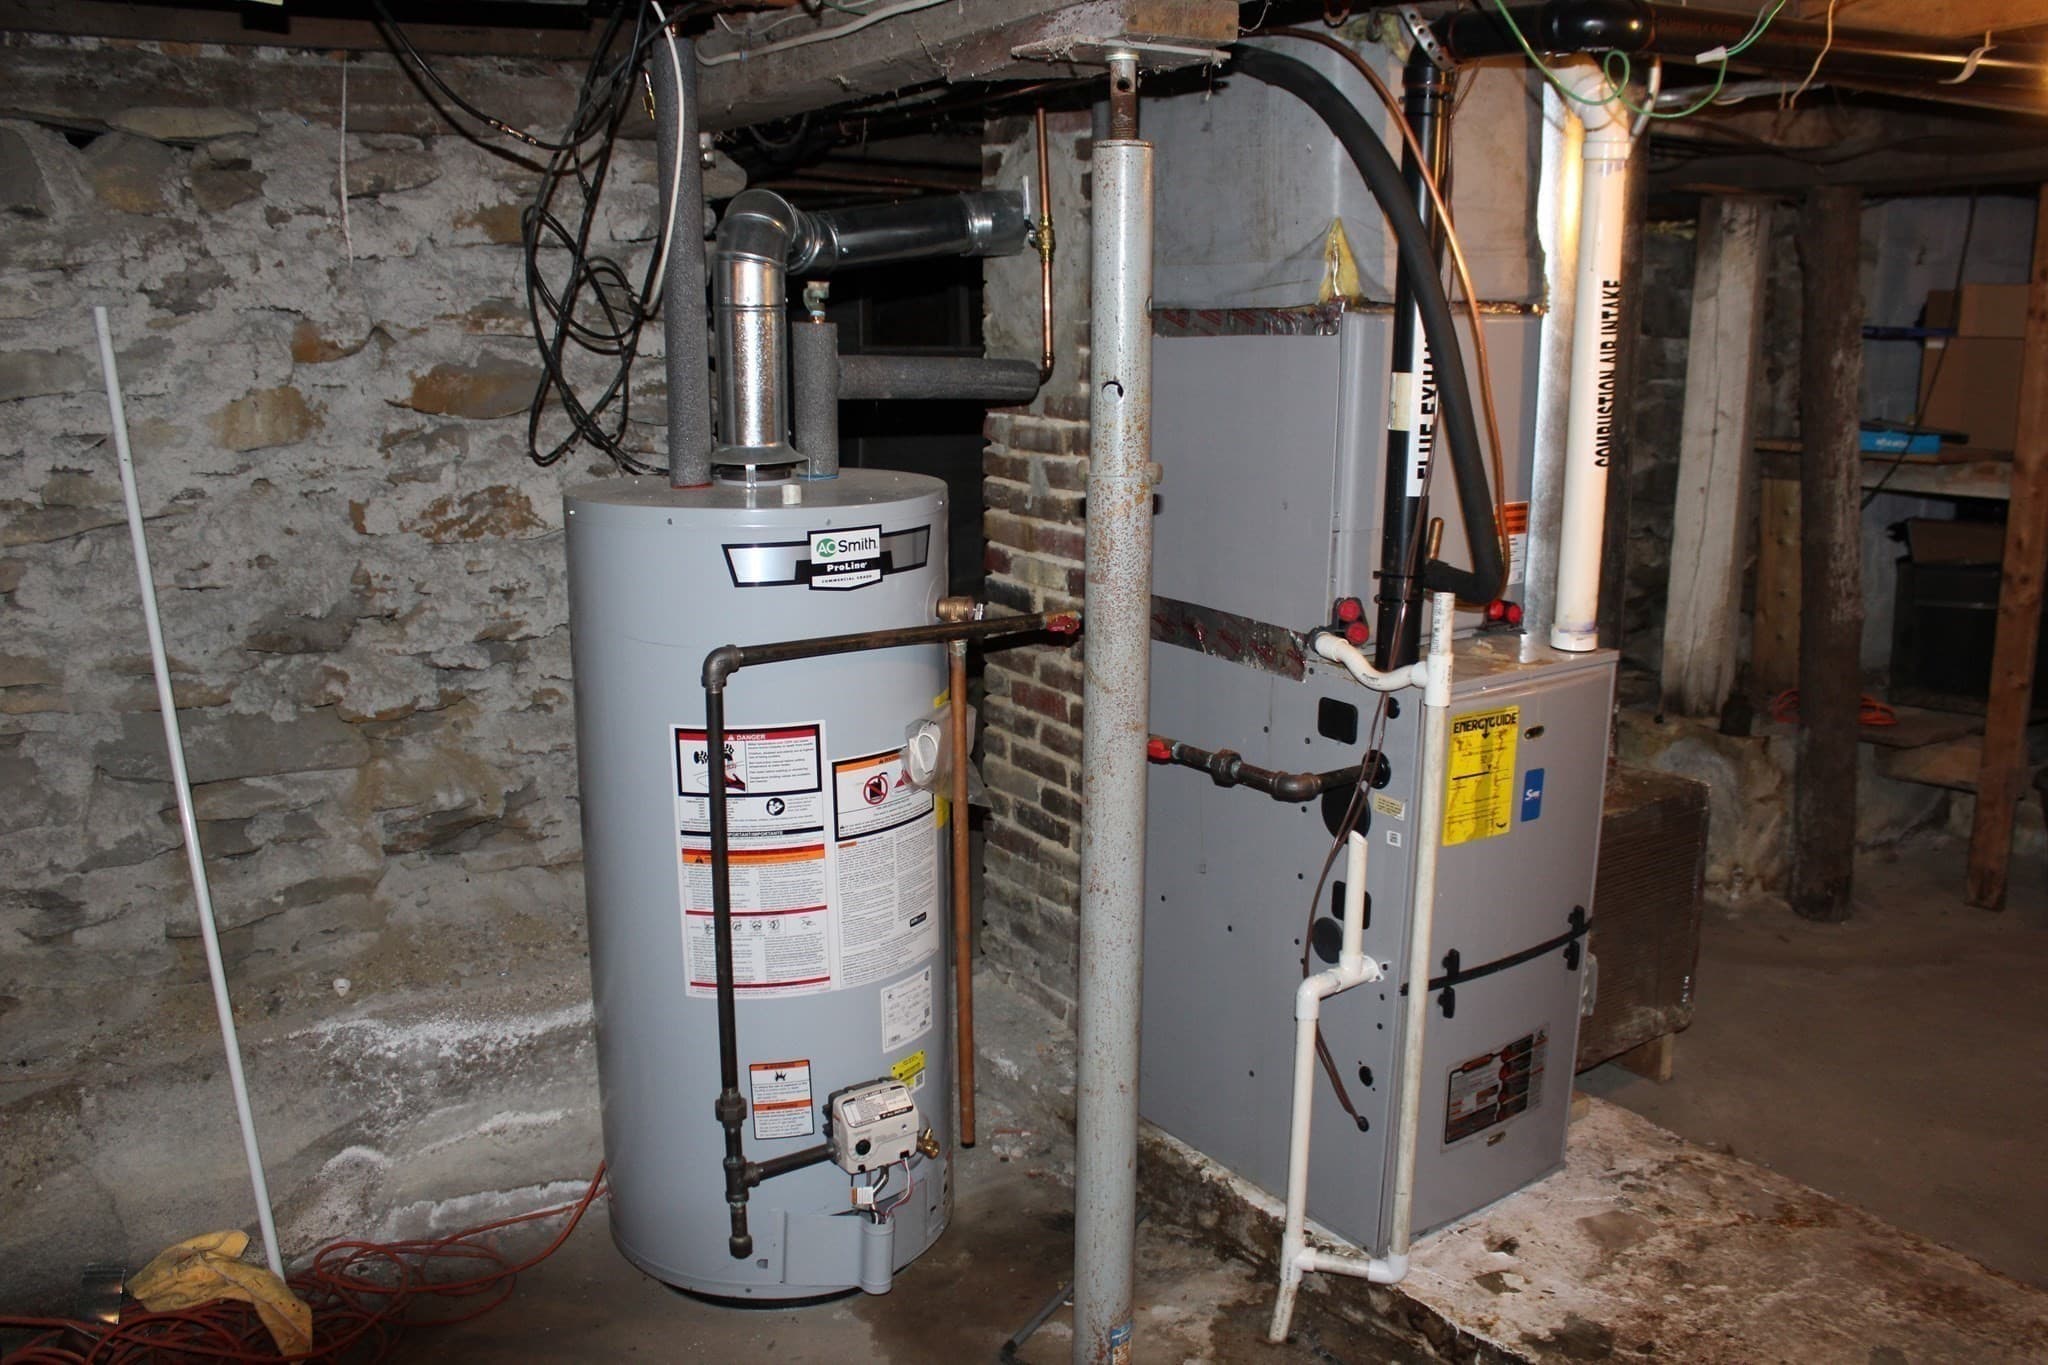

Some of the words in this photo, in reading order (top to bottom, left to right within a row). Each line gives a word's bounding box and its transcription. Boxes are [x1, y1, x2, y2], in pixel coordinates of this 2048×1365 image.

[1601, 280, 1622, 335] INTAKE
[1599, 340, 1617, 365] AIR
[1595, 370, 1616, 467] COMBUSTION
[826, 561, 867, 573] ProLine
[1453, 712, 1518, 735] ENERGYGUIDE
